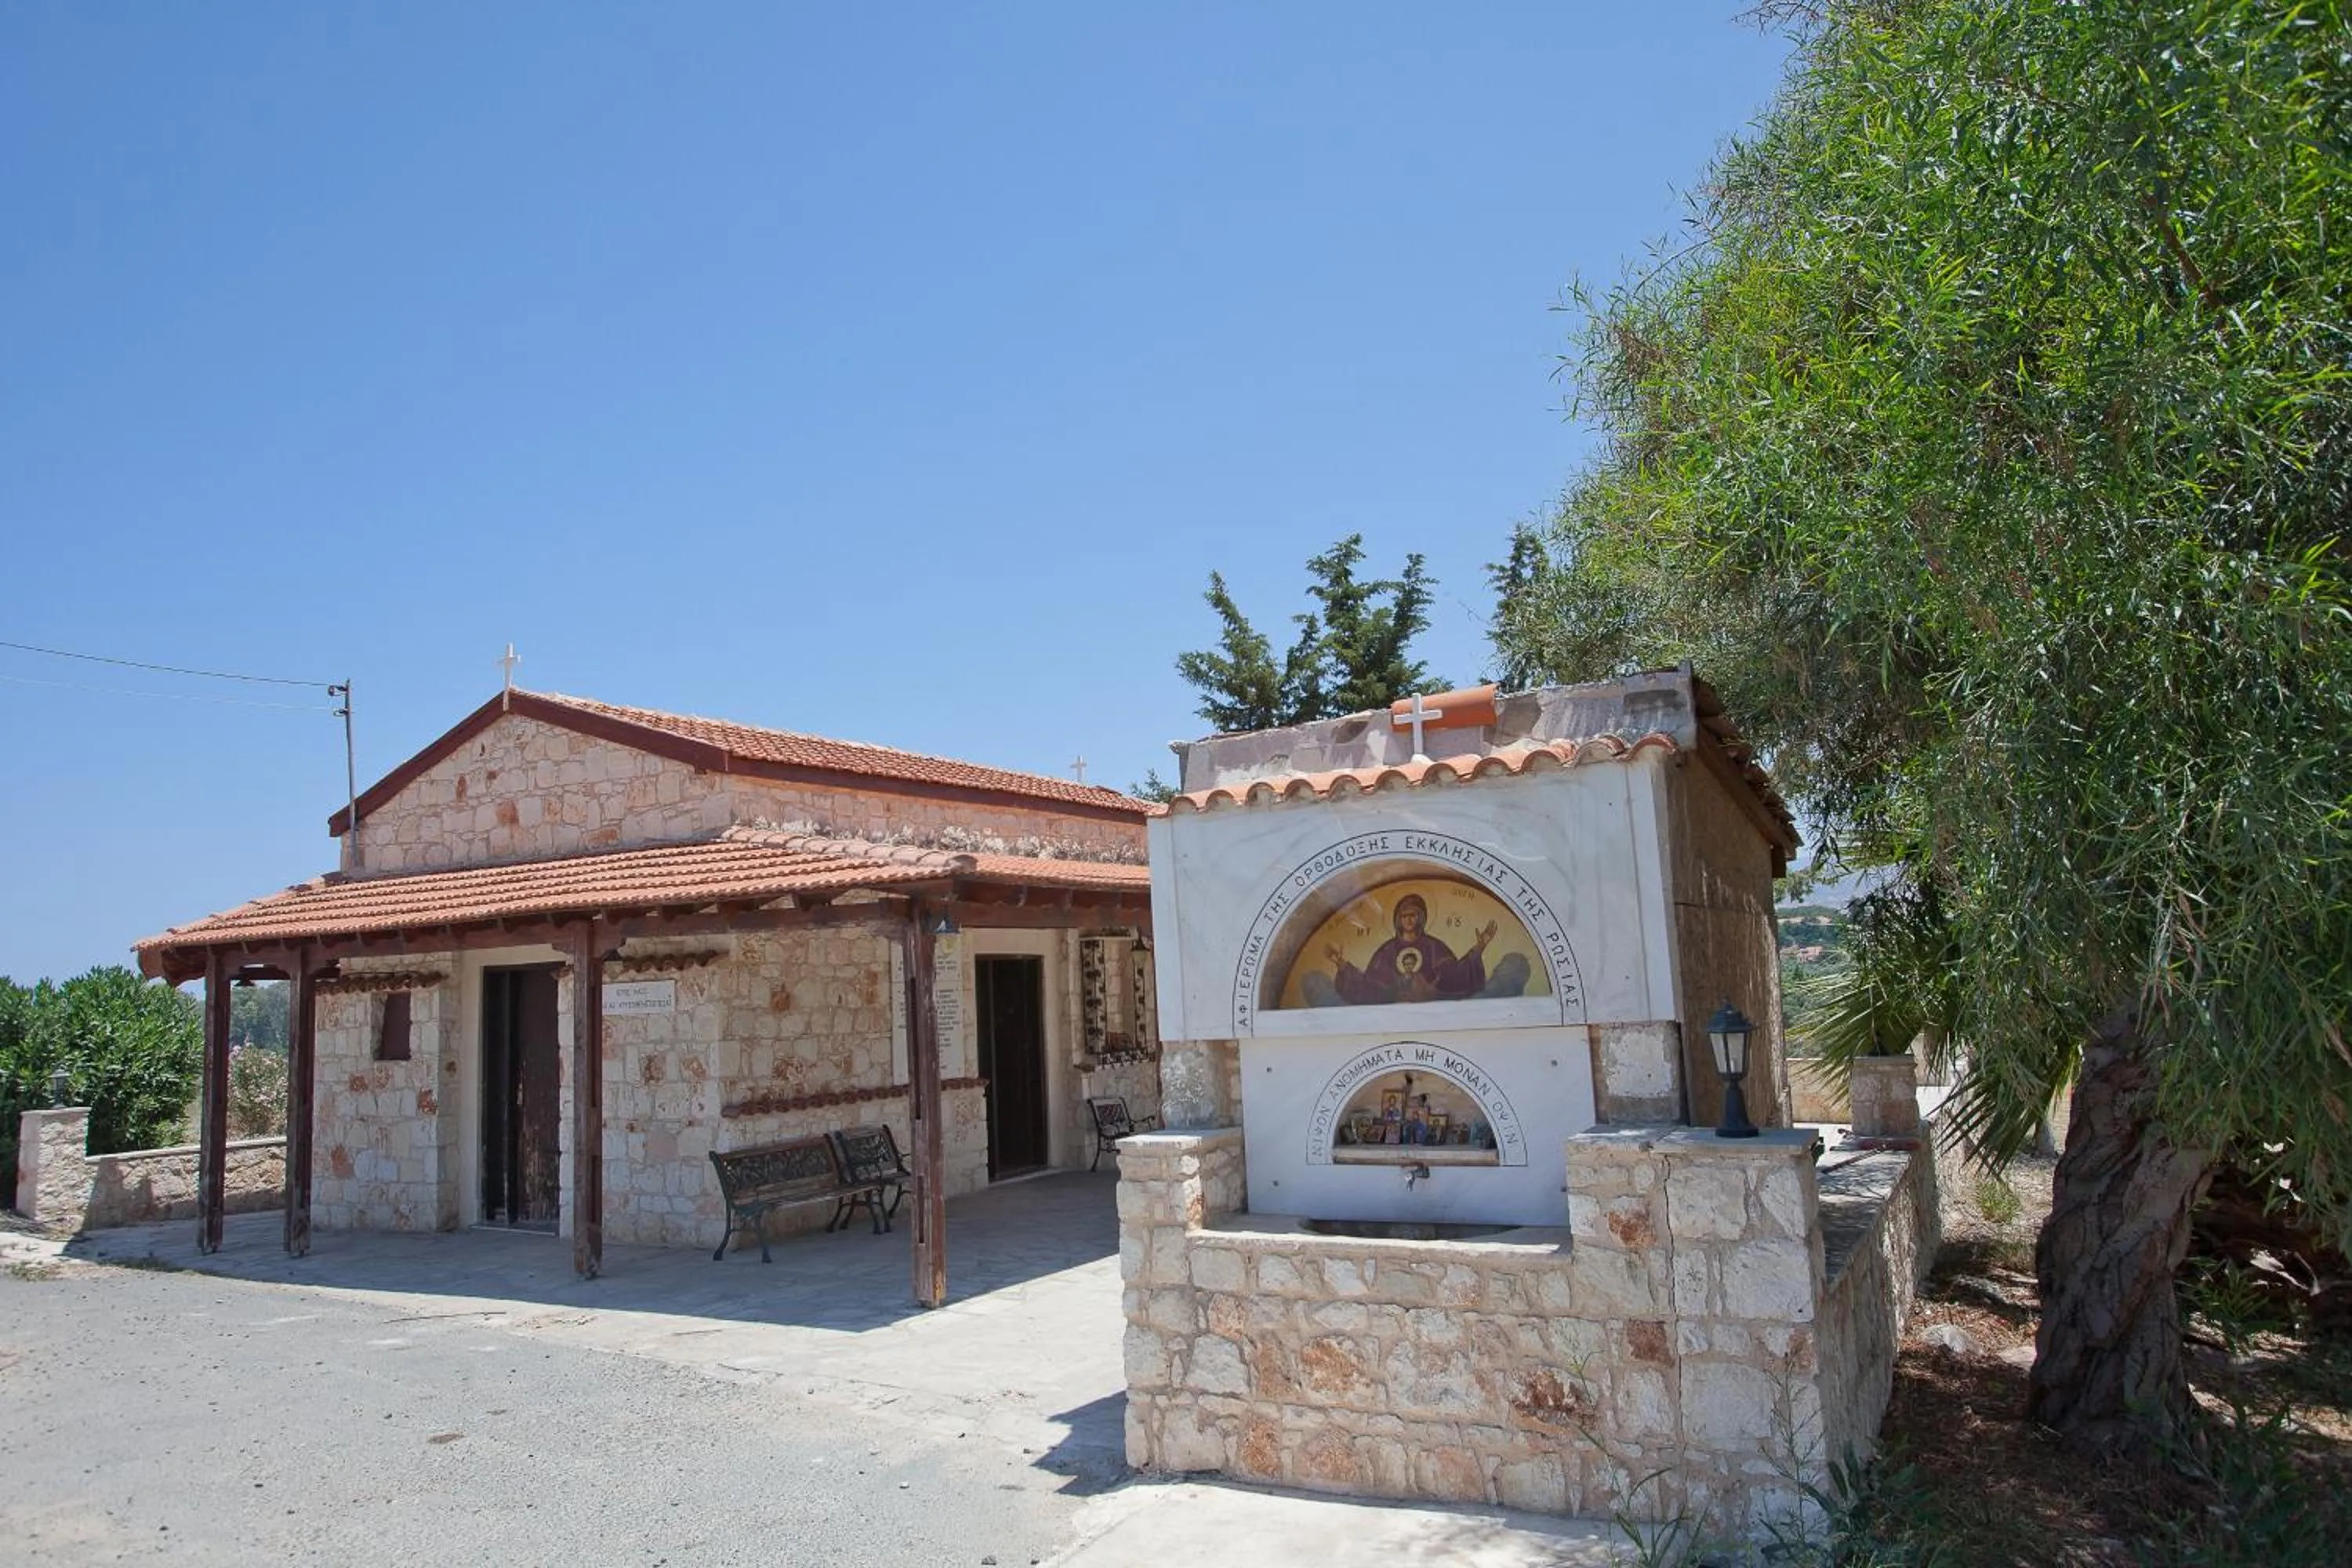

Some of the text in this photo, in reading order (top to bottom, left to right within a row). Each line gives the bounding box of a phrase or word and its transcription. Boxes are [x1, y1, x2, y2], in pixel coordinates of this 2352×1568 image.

[1237, 935, 1264, 1026] ΑΦΙΕΡΩΜΑ
[1264, 893, 1290, 922] ΤΗΣ
[1294, 837, 1390, 887] ΟΡΘΟΔΟΞΗΣ
[1405, 837, 1508, 884] ΕΚΚΛΗΣΙΑΣ
[1516, 887, 1544, 921] ΤΗΣ
[1546, 932, 1579, 1007] ΡΩΣΙΑΣ
[1312, 1048, 1518, 1156] ΝΙΨΟΝ ΑΝΟΜΗΜΑΤΑ ΜΗ ΜΟΝΑΝ ΟΨΙΝ
